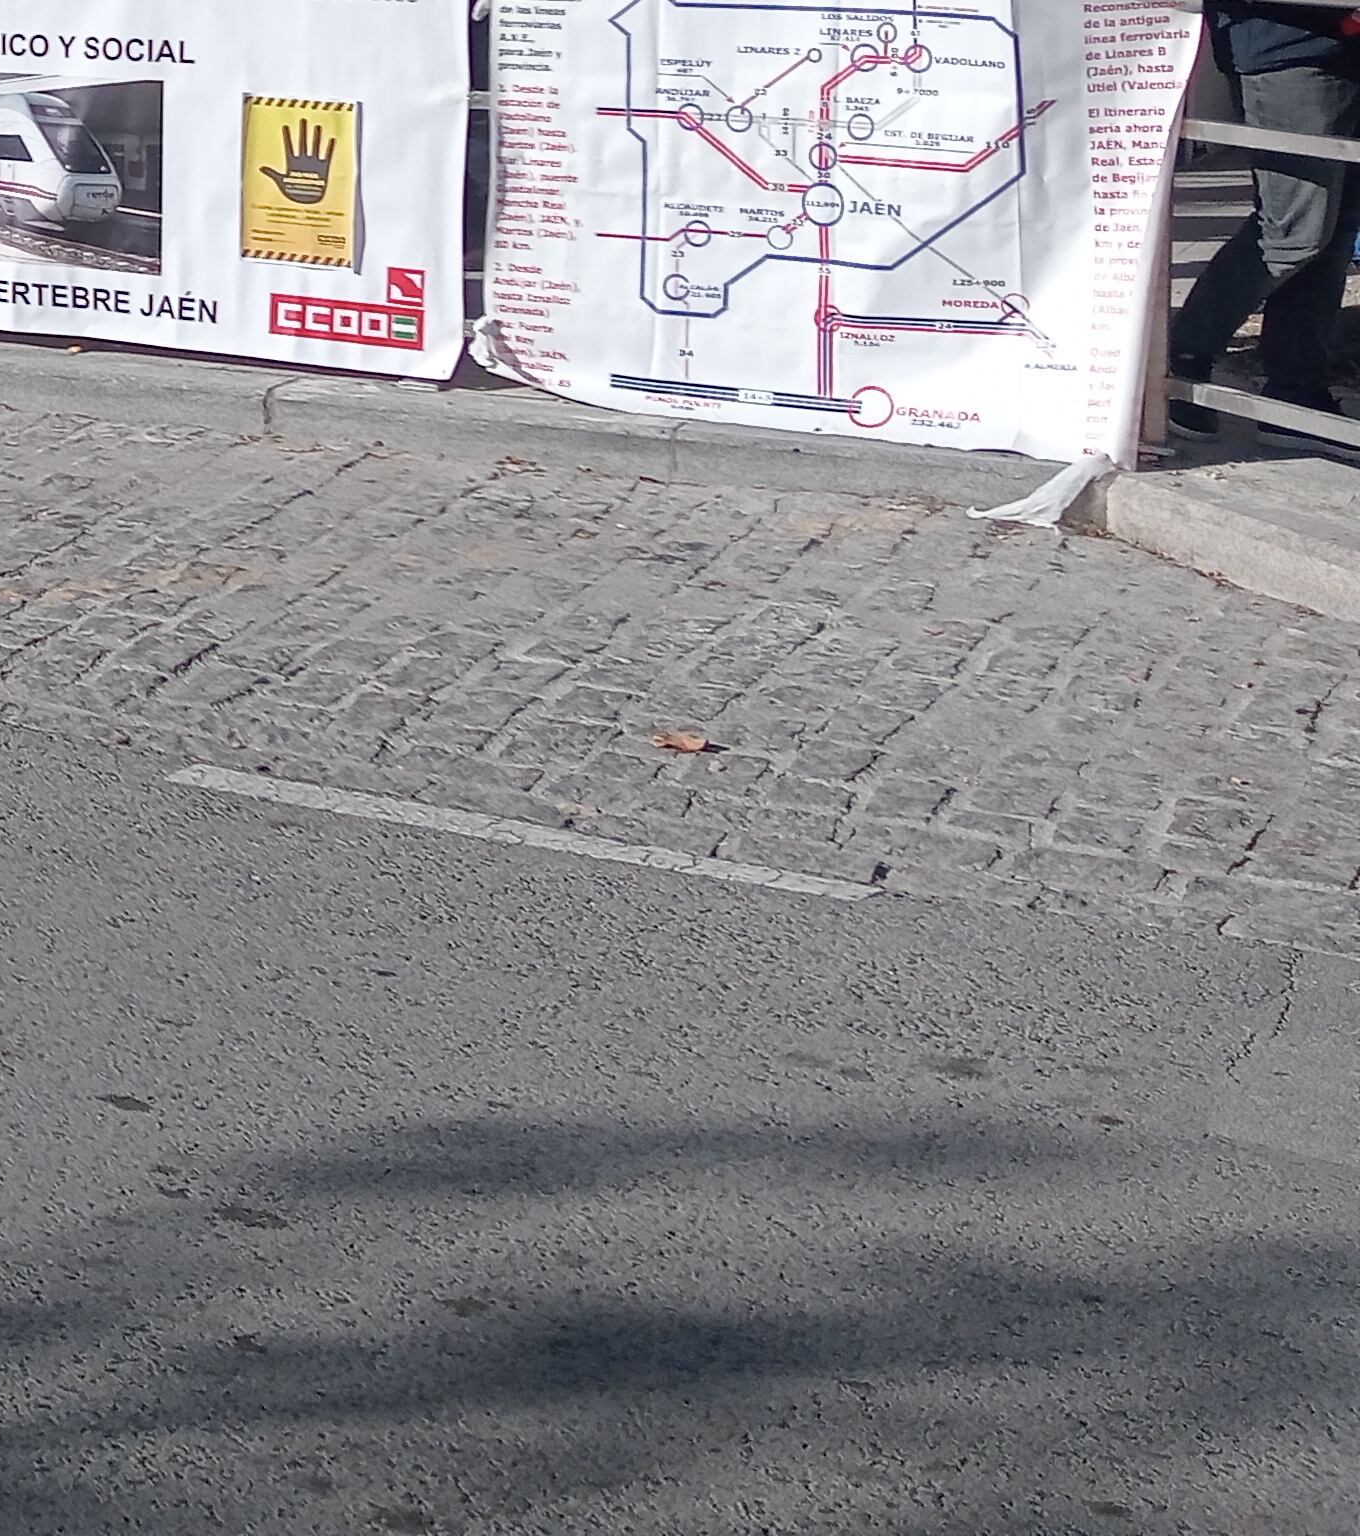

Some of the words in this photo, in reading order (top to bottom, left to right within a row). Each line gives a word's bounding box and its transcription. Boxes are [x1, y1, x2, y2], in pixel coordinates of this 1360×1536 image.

[1084, 18, 1101, 29] de
[1104, 18, 1116, 28] la
[1119, 15, 1170, 28] antigua
[819, 27, 873, 37] LINARES
[1120, 29, 1191, 43] ferroviaria
[58, 36, 76, 59] Y
[83, 36, 195, 64] SOCIAL
[1085, 51, 1102, 61] de
[1105, 47, 1154, 59] Linares
[934, 56, 1006, 69] VADOLLANO
[1137, 63, 1174, 73] hasta
[1088, 108, 1100, 118] El
[1125, 122, 1163, 133] ahora
[1092, 172, 1108, 183] de
[1093, 189, 1129, 199] hasta
[848, 199, 902, 217] JAÉN
[1094, 205, 1106, 215] la
[1094, 223, 1110, 232] de
[141, 292, 218, 324] JAÉN
[941, 299, 1000, 310] MOREDA
[277, 301, 391, 338] CCOO
[896, 406, 981, 423] GRANADA
